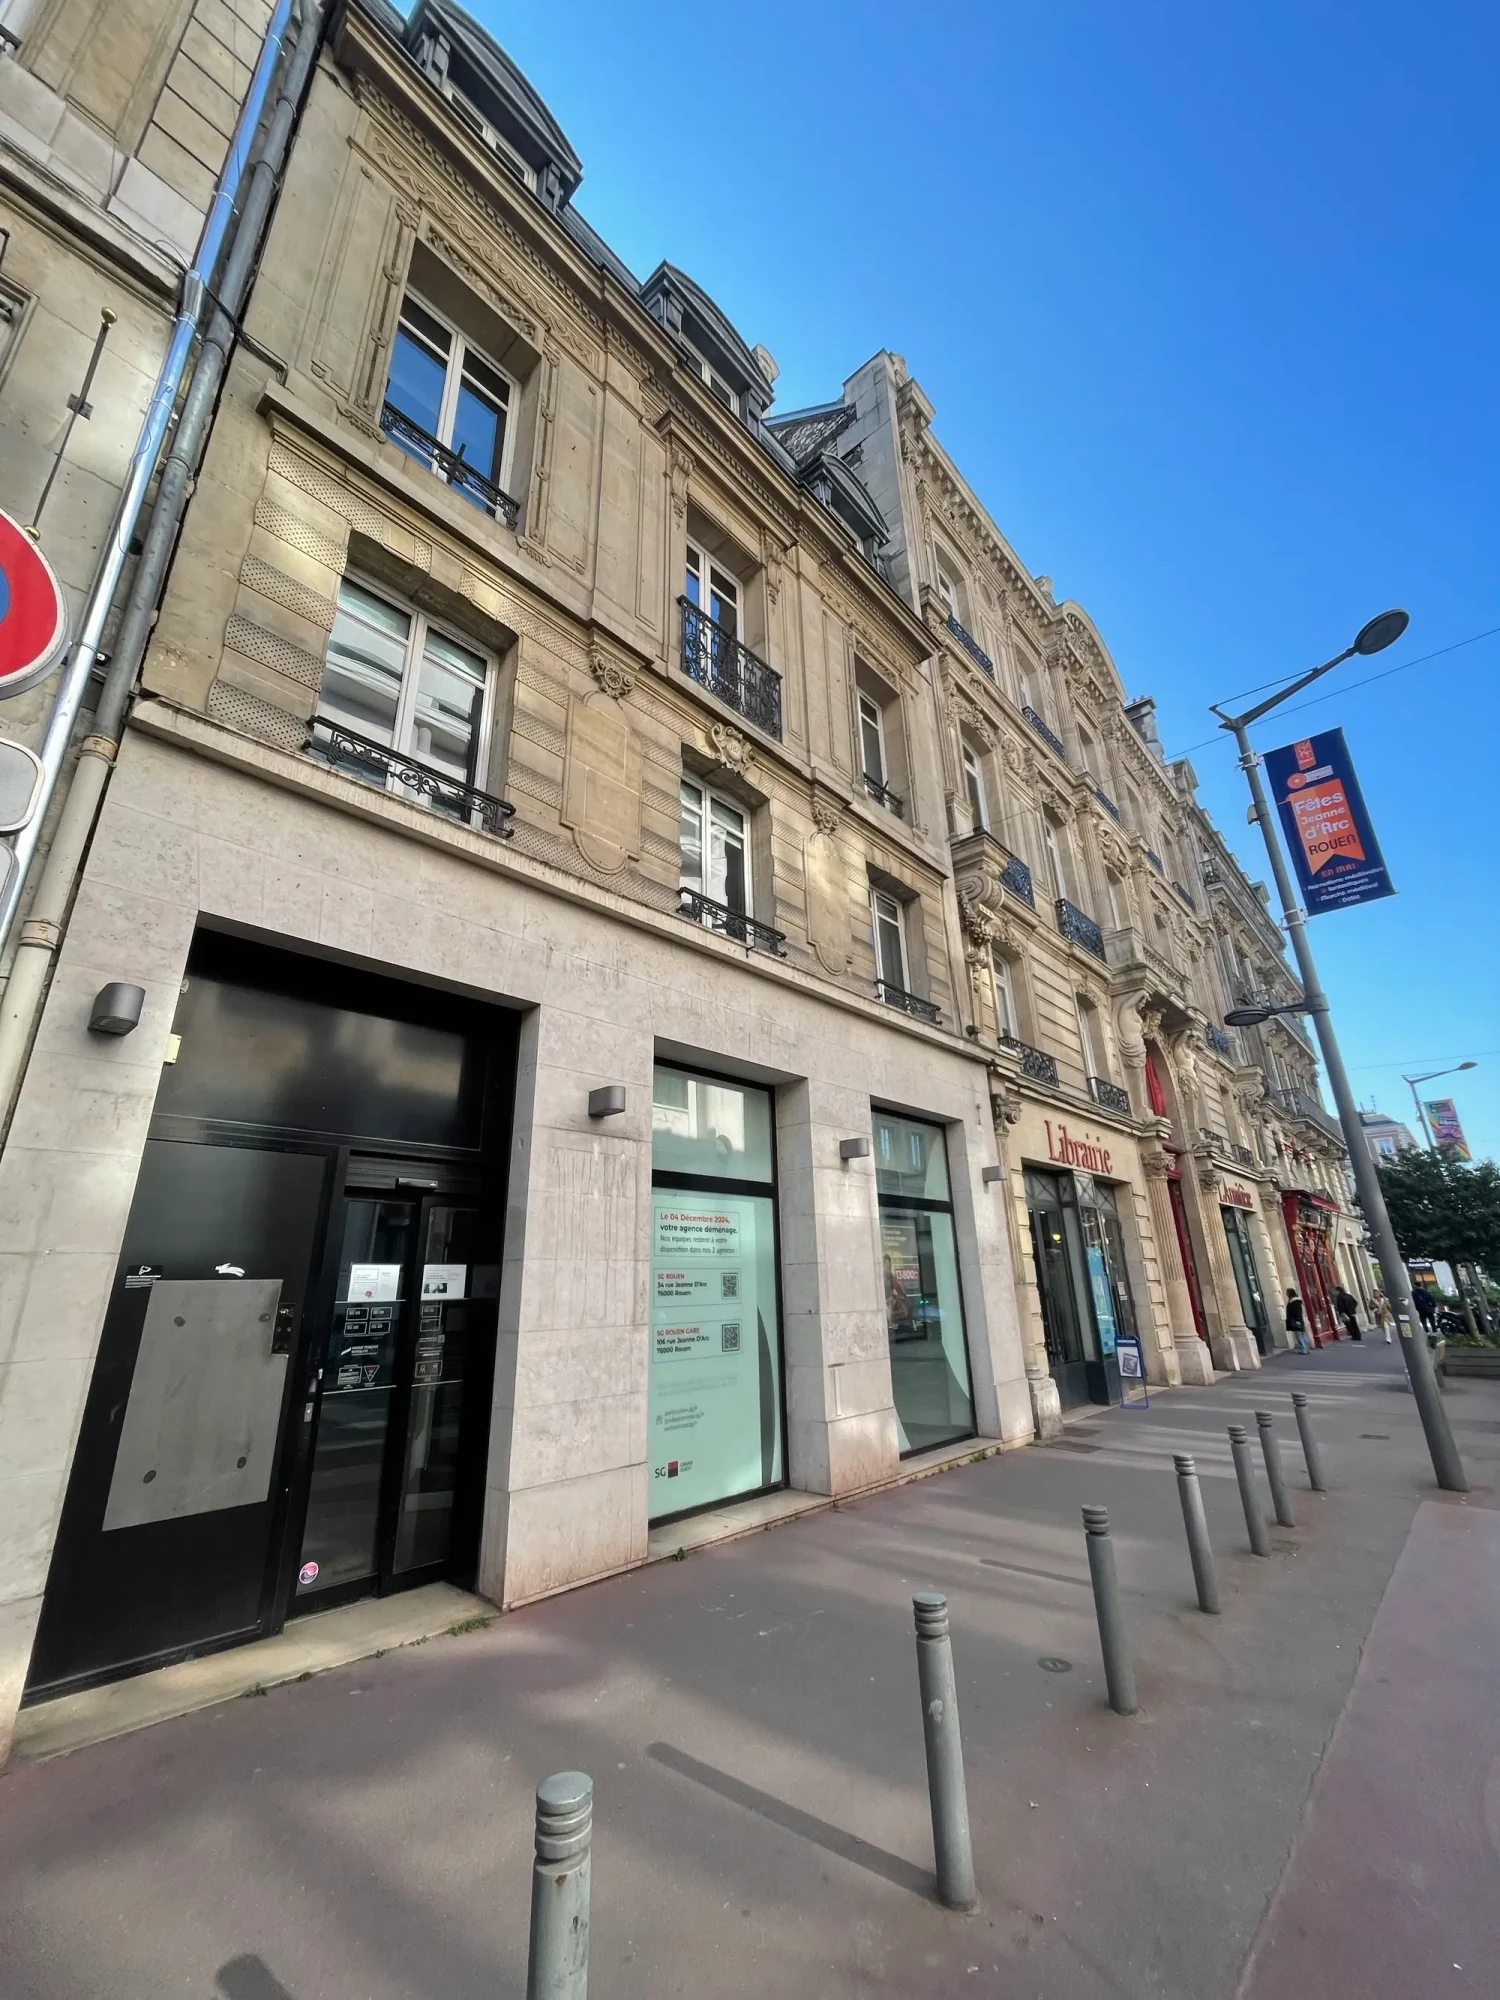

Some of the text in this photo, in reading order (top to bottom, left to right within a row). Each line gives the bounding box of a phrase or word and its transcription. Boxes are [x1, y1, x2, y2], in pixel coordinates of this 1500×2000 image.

[1295, 792, 1344, 814] Fêtes
[1301, 807, 1345, 825] Jeanne
[1305, 820, 1349, 839] d'Arc
[1044, 1120, 1113, 1174] Librairie
[681, 1214, 712, 1222] Décembre
[704, 1226, 738, 1235] déménage.
[655, 1467, 666, 1478] SG
